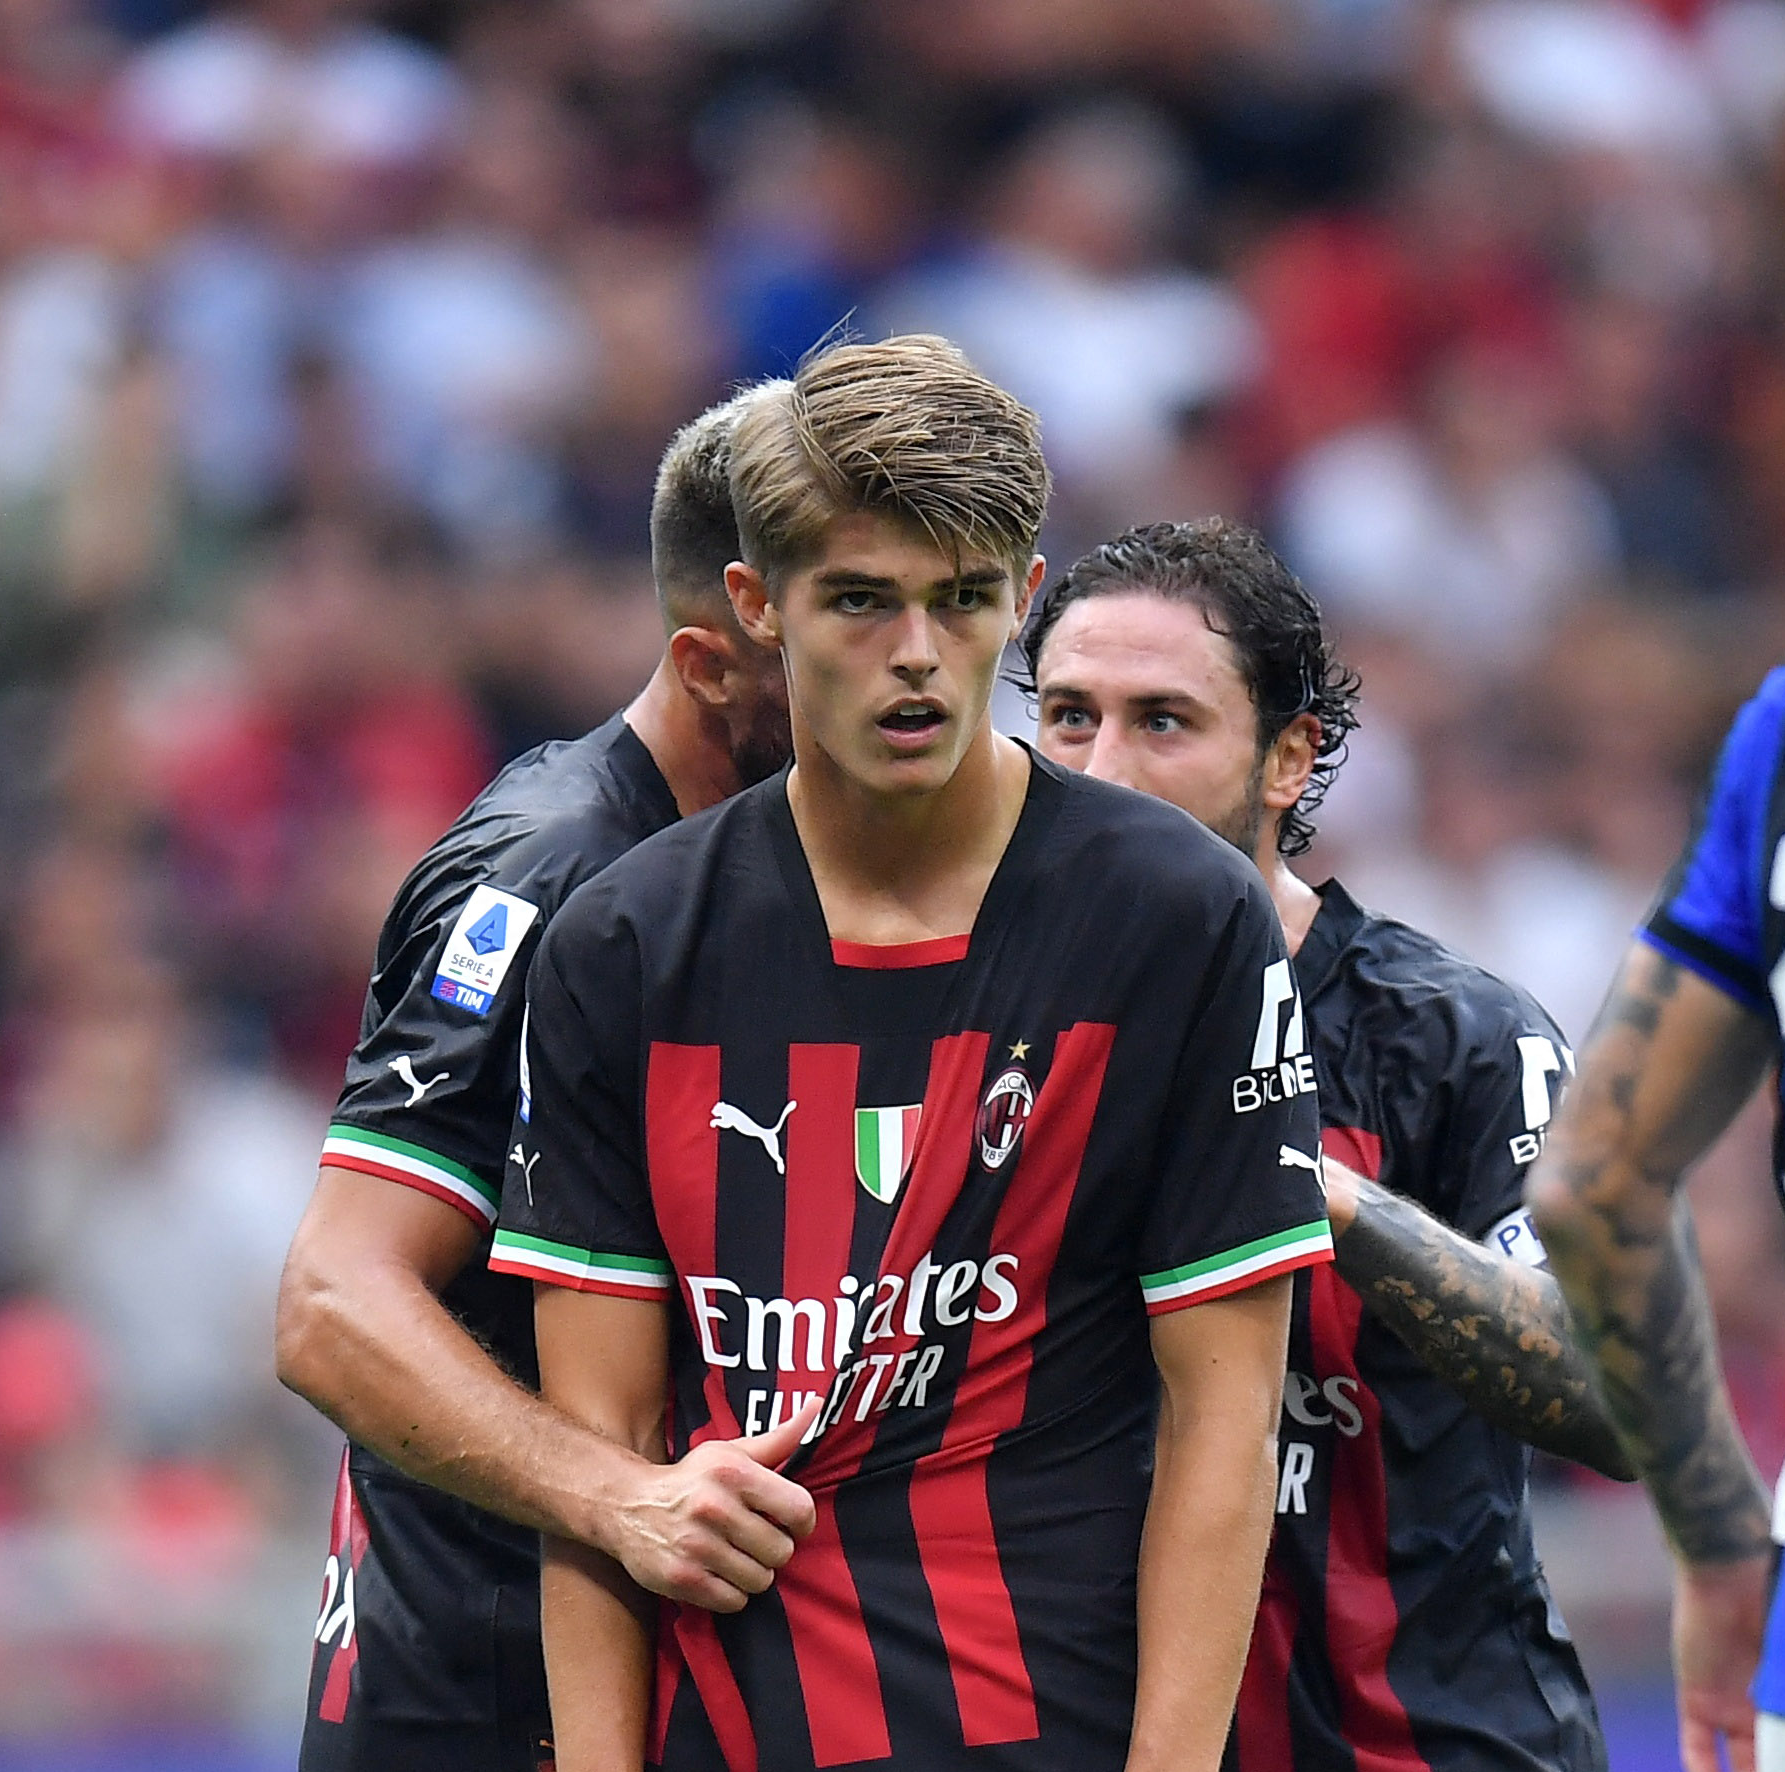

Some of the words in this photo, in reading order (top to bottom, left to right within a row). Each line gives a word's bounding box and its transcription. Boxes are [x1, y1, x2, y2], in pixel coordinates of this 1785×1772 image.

[450, 953, 485, 975] SERIE
[485, 967, 494, 979] A
[455, 985, 485, 1010] TIM
[684, 1250, 1020, 1373] Emirates
